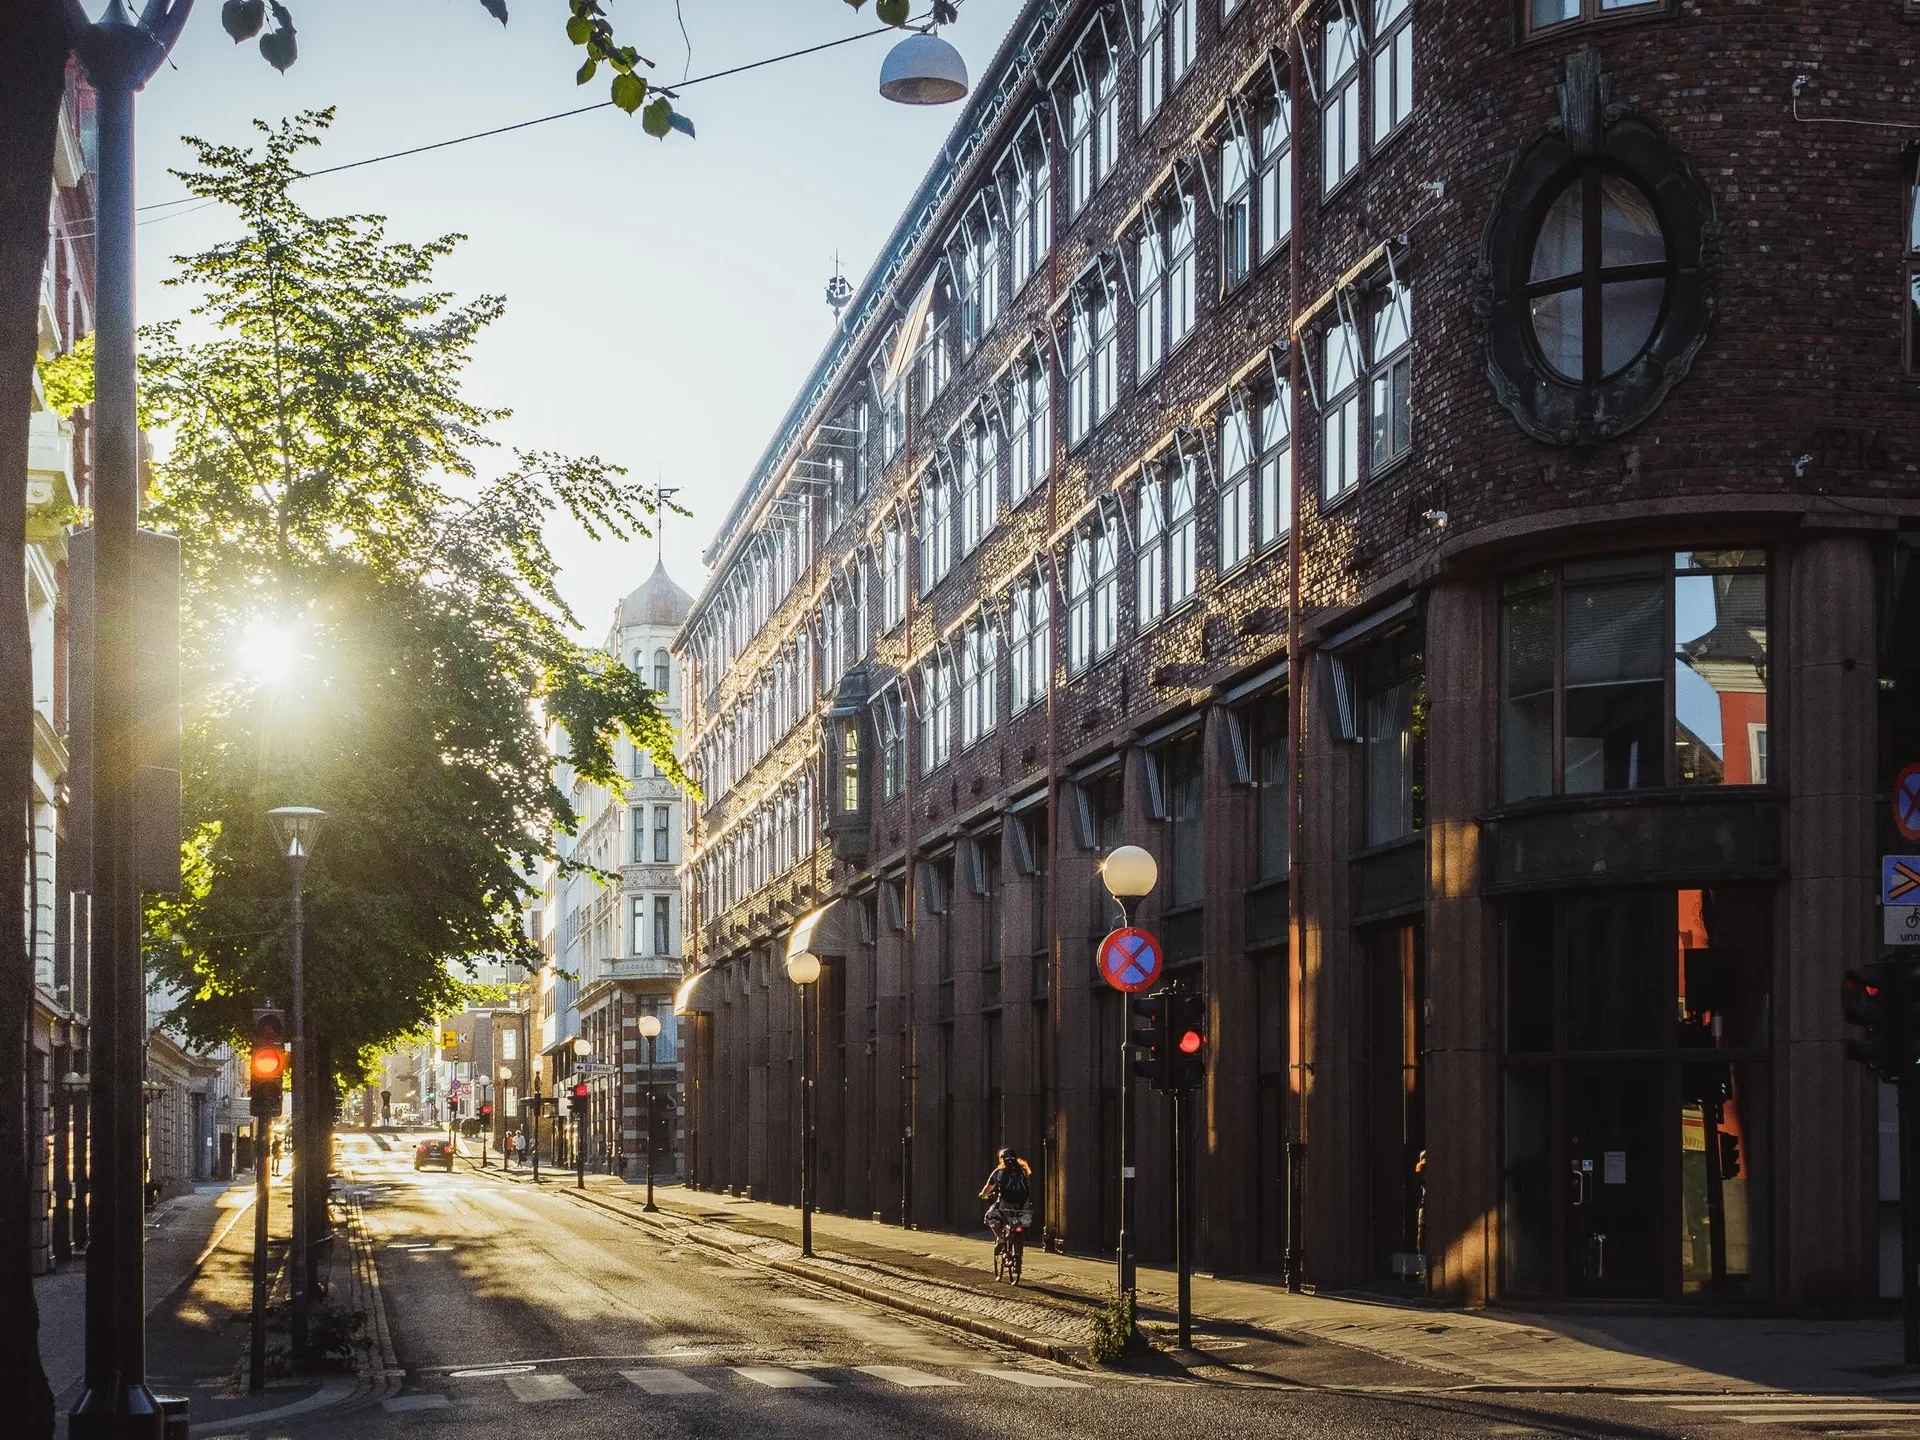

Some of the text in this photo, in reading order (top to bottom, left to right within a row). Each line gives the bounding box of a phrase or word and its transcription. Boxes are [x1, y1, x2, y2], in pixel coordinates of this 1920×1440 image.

[1813, 427, 1887, 471] 1916
[1901, 933, 1920, 942] unn
[457, 1032, 468, 1043] K
